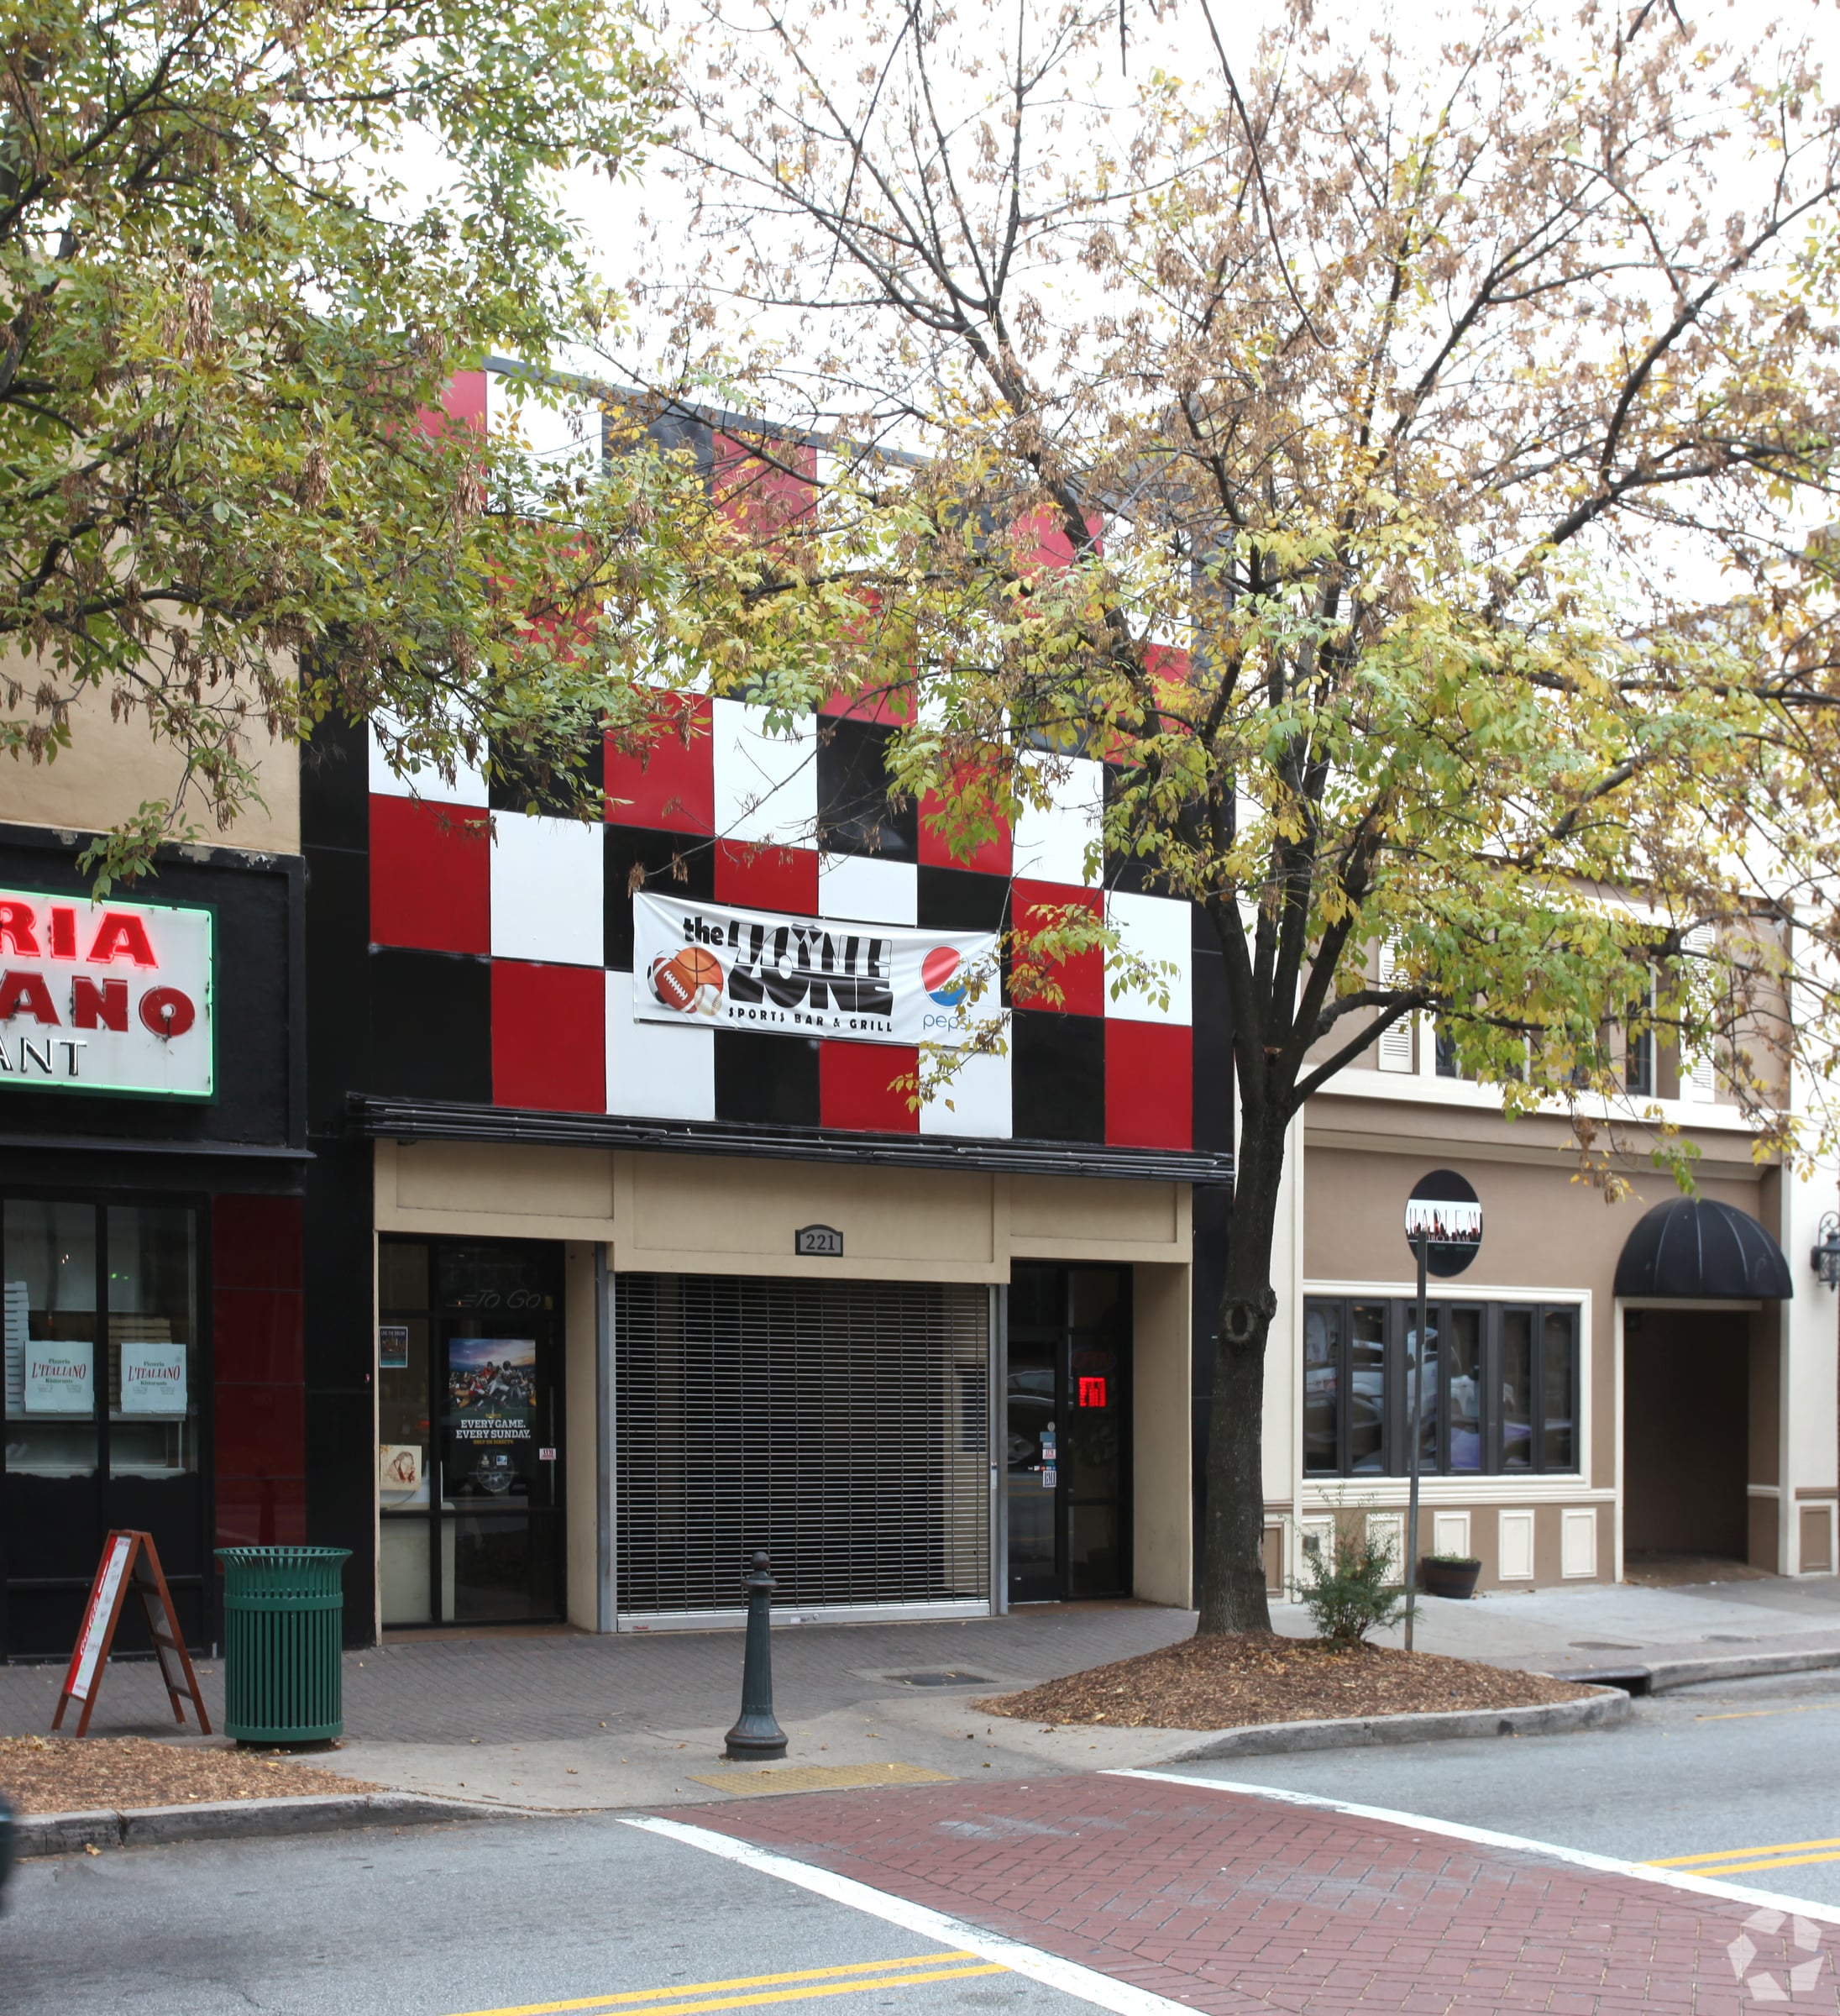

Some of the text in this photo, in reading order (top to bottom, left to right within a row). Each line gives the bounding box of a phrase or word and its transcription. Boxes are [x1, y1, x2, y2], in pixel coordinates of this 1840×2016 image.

[0, 900, 159, 969] RIA
[682, 916, 894, 1016] the ZONE
[0, 969, 196, 1037] ANO
[729, 1007, 893, 1032] SPORTS BAR & GRILL
[1409, 1207, 1479, 1238] HARLEM
[806, 1233, 835, 1251] 221
[474, 1289, 542, 1310] To Go
[456, 1430, 531, 1439] EVERY SUNDAY.
[460, 1419, 527, 1429] EVERY GAME.
